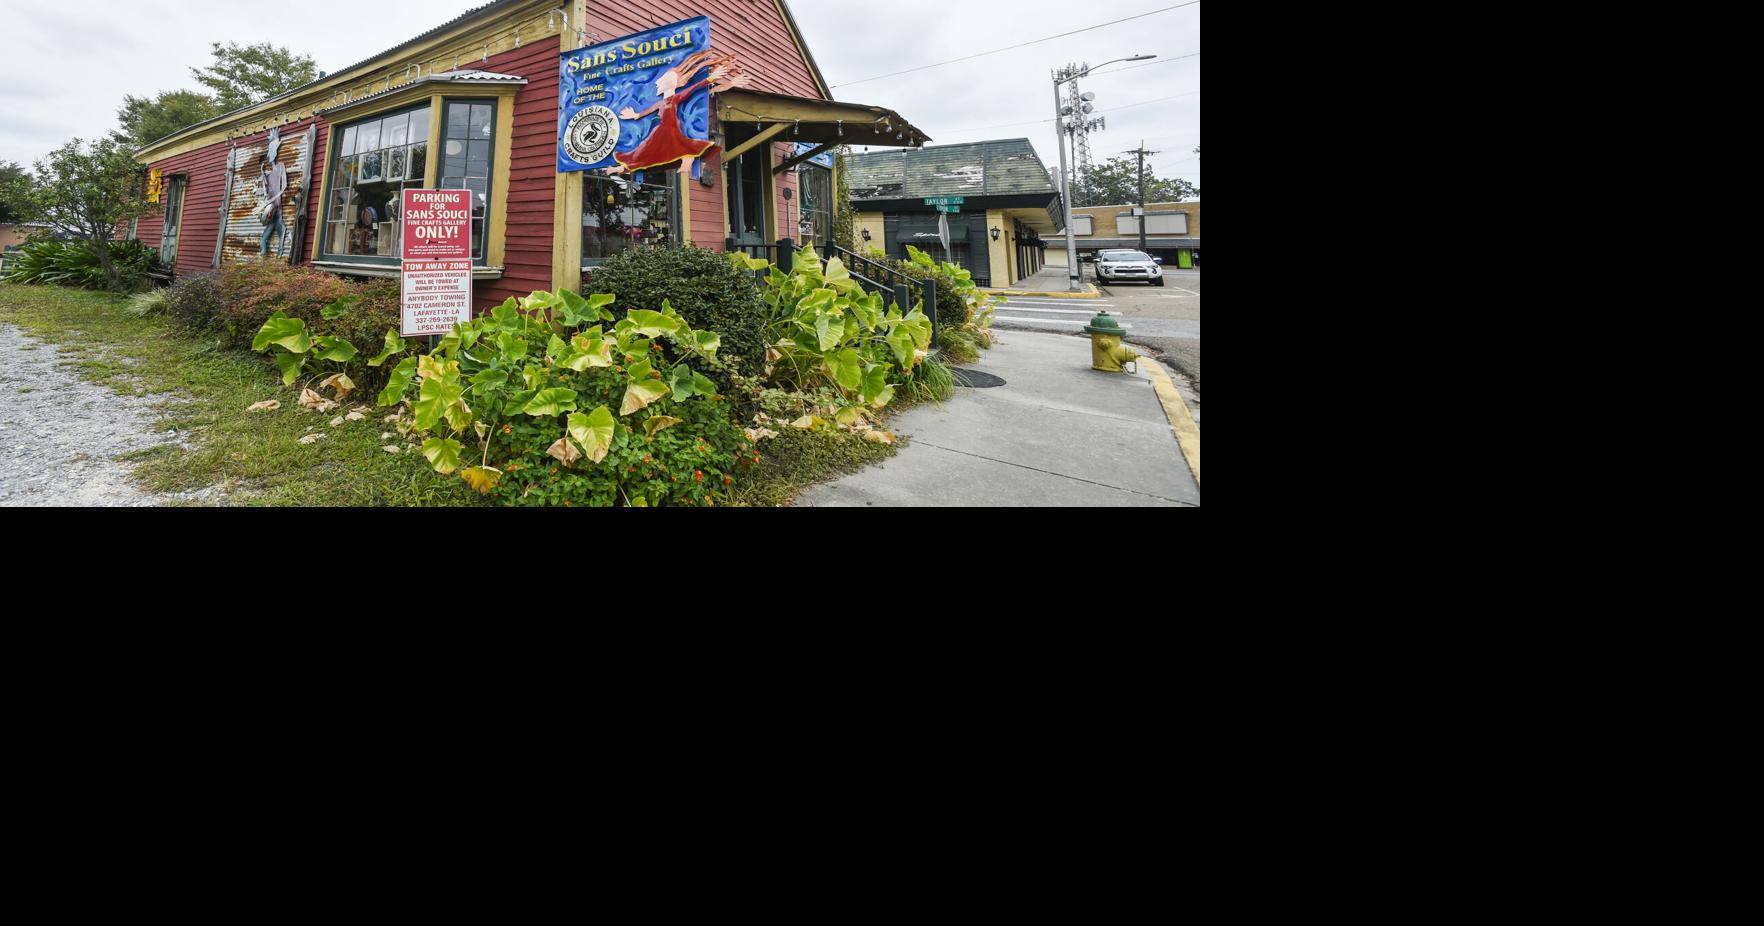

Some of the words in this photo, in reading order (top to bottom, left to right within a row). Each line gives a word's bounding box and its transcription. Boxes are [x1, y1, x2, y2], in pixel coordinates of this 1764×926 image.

[567, 48, 617, 74] Sans
[621, 26, 693, 60] Souci
[583, 71, 602, 81] Fine
[605, 63, 635, 76] Crafts
[636, 55, 673, 69] Gallery
[576, 83, 604, 95] HOME
[573, 95, 585, 105] OF
[586, 92, 606, 102] THE
[568, 106, 614, 129] LOUISIANA
[564, 142, 589, 163] CRAFTS
[592, 138, 614, 161] GUILD
[412, 193, 460, 203] PARKING
[925, 198, 948, 206] TAYLOR
[406, 210, 434, 219] SANS
[436, 210, 468, 219] SOUCI
[415, 225, 459, 239] ONLY!
[405, 263, 423, 271] TOW
[449, 262, 469, 270] ZONE
